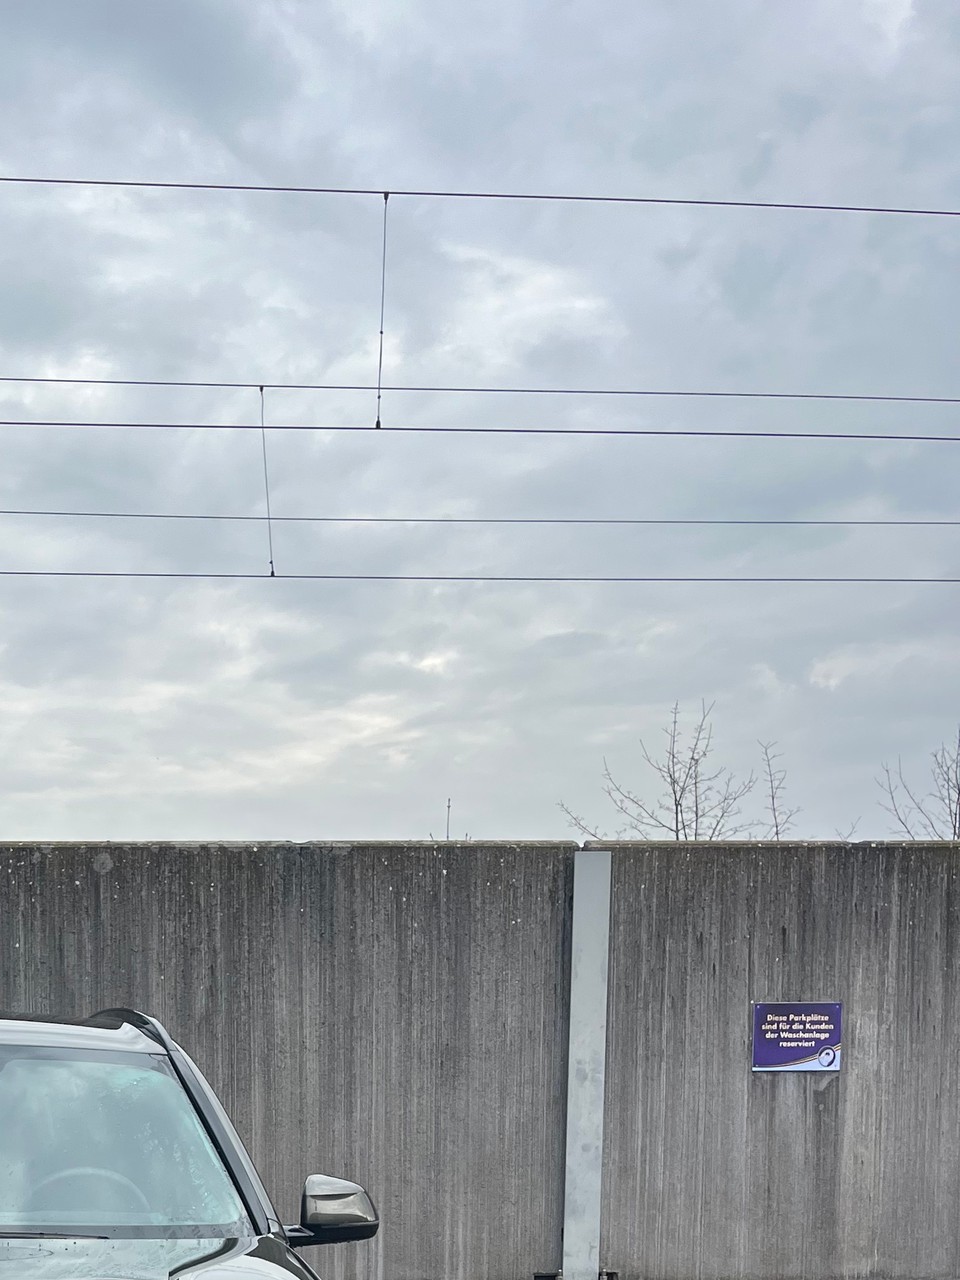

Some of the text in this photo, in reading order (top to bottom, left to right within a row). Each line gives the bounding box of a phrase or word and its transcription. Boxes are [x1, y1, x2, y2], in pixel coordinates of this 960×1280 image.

[766, 1013, 829, 1023] Diese Parkplätze
[761, 1023, 834, 1031] sind für die Kunden
[765, 1031, 830, 1040] der Waschanlage
[779, 1040, 816, 1048] reserviert
